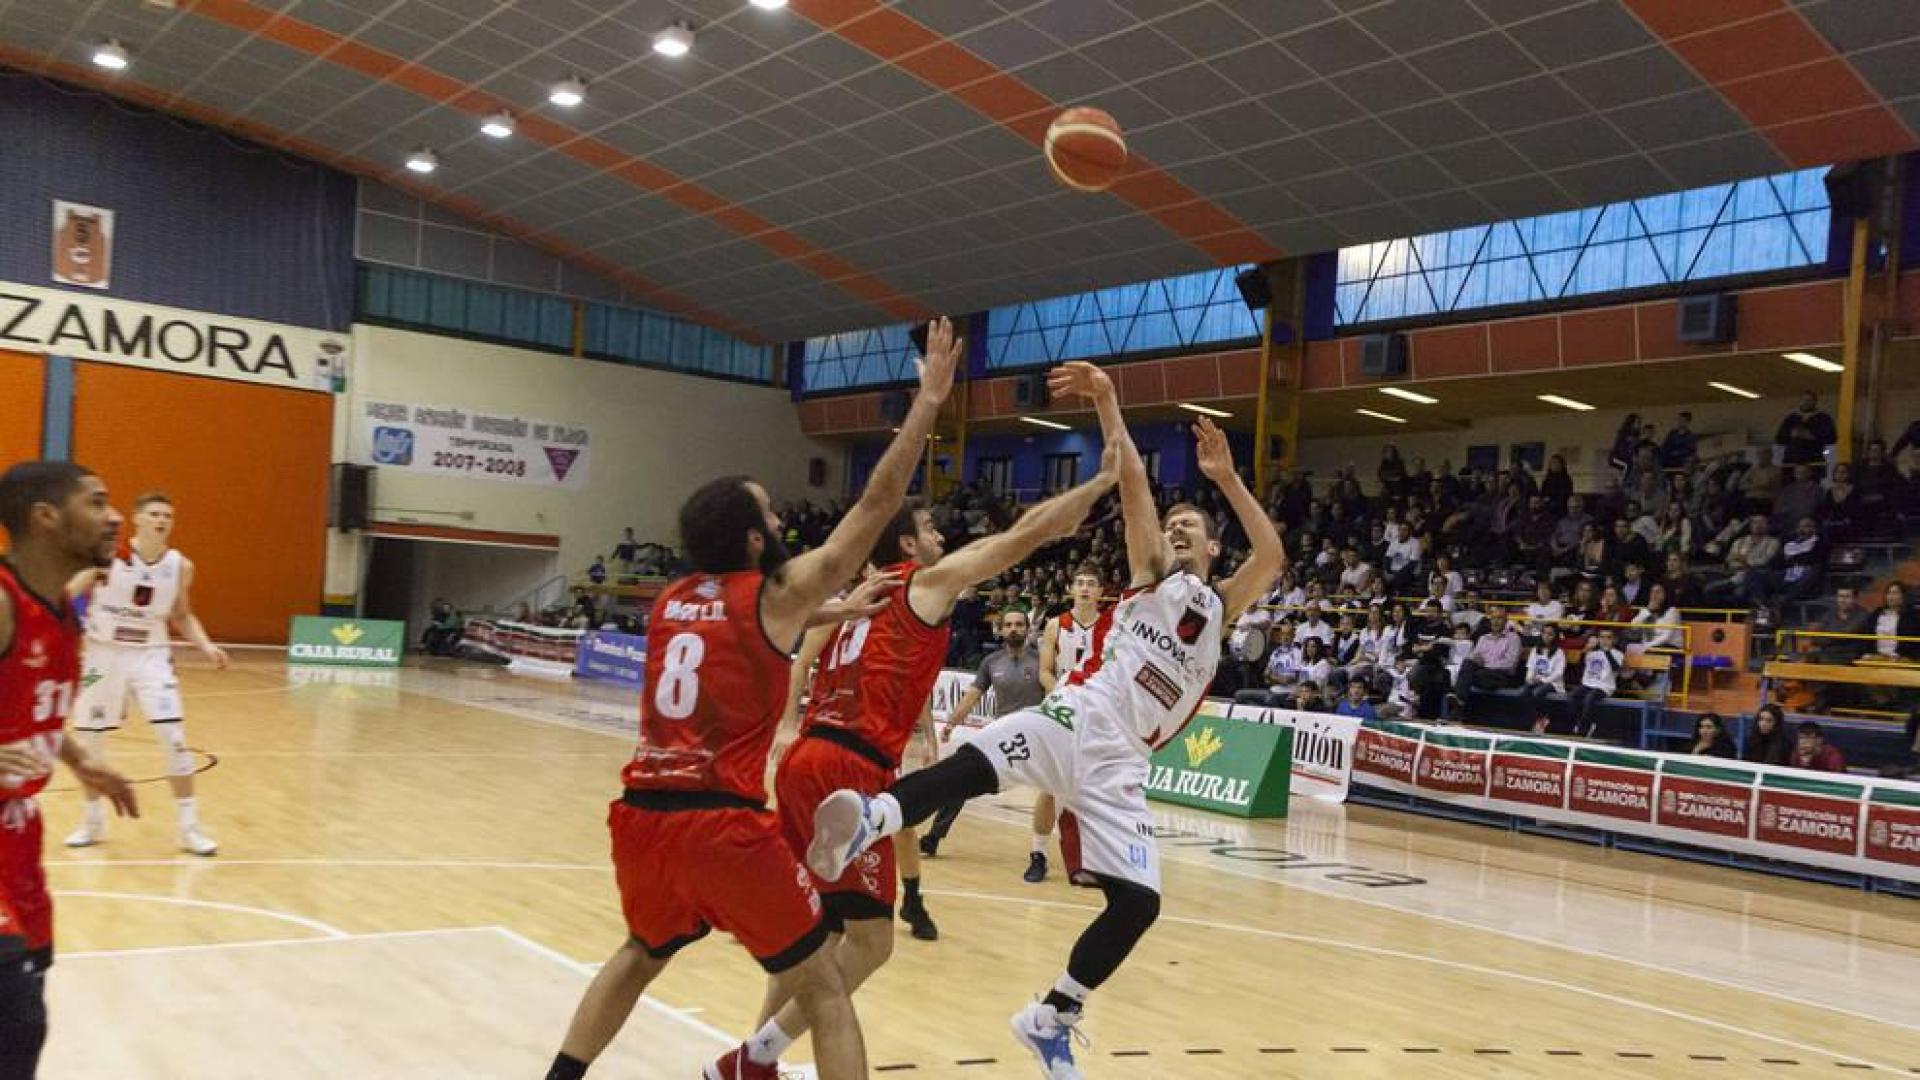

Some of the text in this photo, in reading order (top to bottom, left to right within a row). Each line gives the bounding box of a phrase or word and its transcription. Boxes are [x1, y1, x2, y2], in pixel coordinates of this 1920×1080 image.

[0, 293, 297, 379] ZAMORA
[432, 451, 526, 478] 2007-2008
[336, 646, 398, 662] RURAL
[655, 632, 705, 720] 8
[33, 680, 72, 722] 31
[998, 732, 1031, 768] 32
[1368, 751, 1411, 773] ZAMORA
[1173, 768, 1250, 805] RURAL
[1430, 767, 1484, 786] ZAMORA
[1506, 776, 1561, 796] ZAMORA
[1586, 788, 1648, 810] ZAMORA
[1677, 802, 1745, 824] ZAMORA
[1777, 817, 1854, 841] ZAMORA
